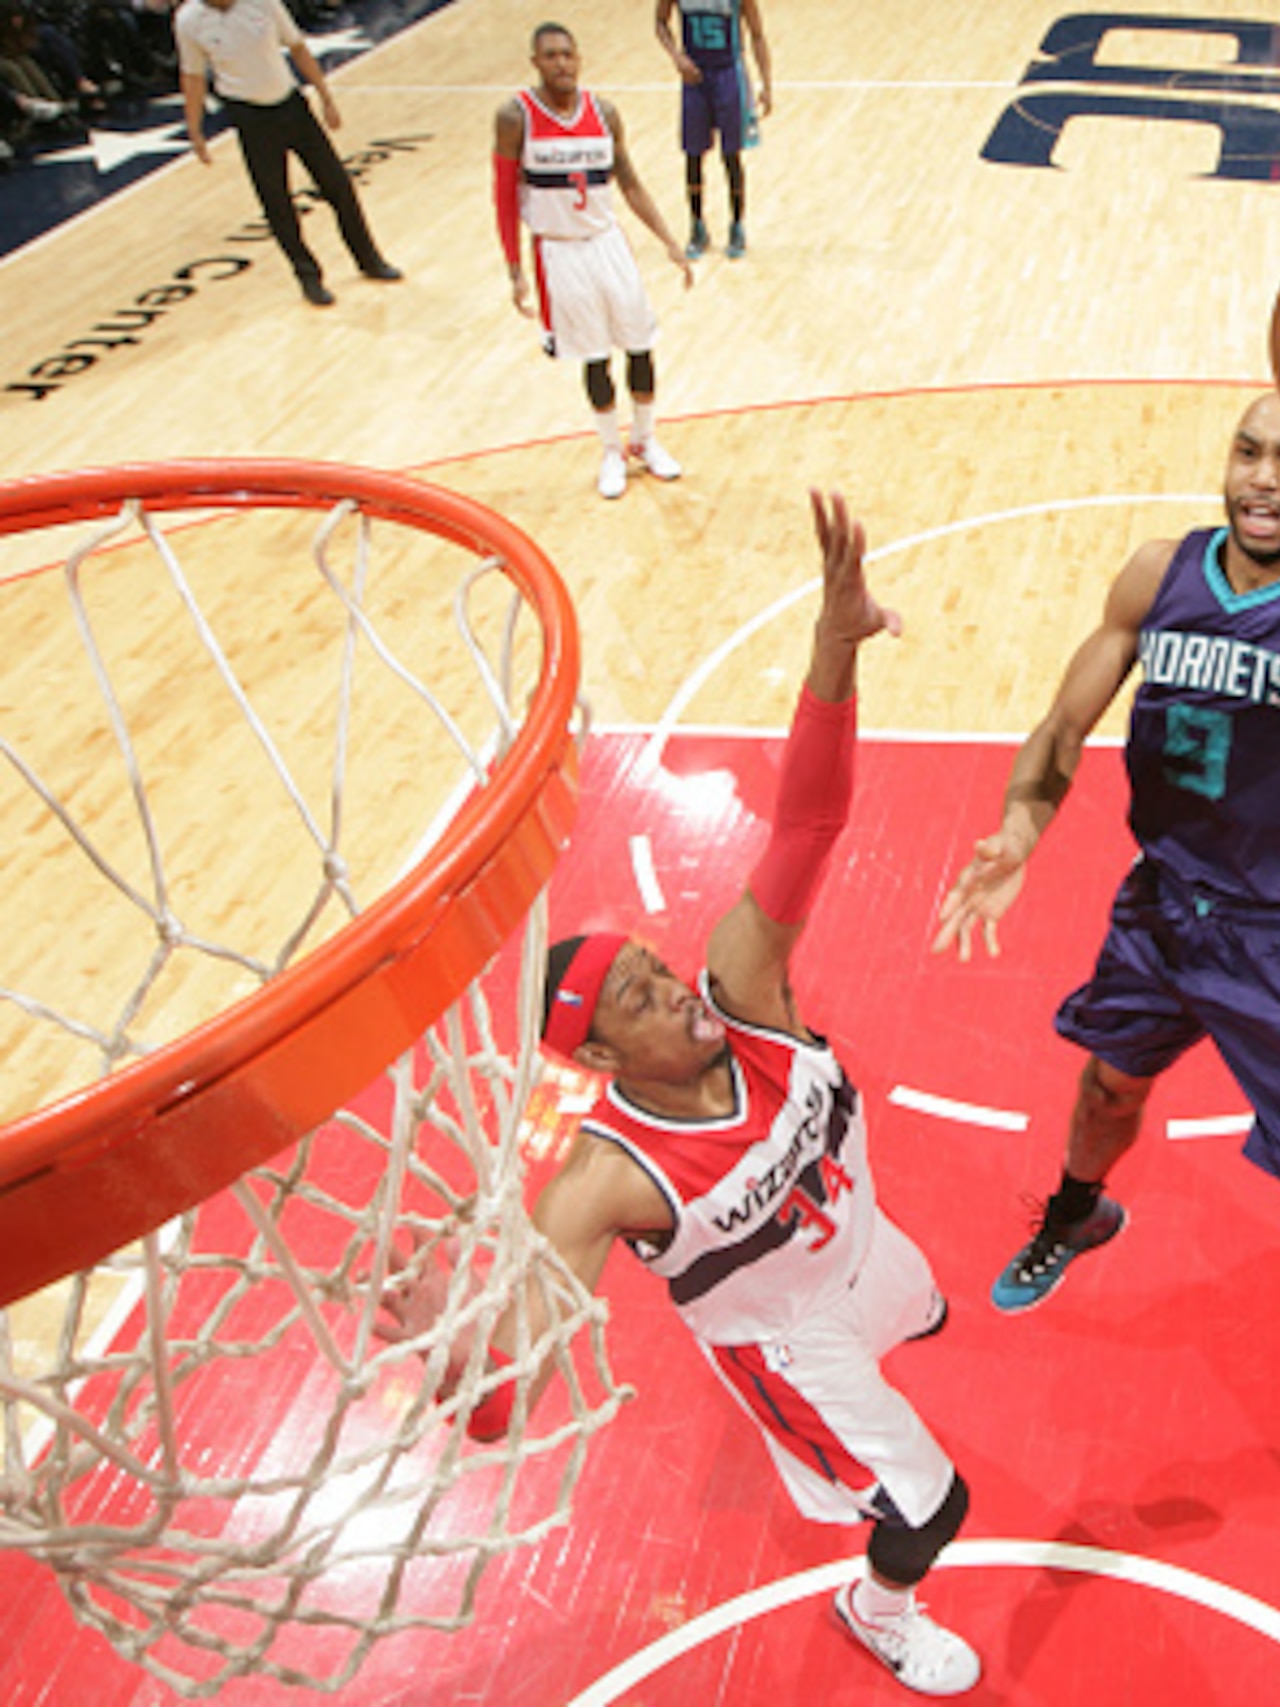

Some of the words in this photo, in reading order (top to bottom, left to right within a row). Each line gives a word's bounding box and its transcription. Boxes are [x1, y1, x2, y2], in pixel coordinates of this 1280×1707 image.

[688, 15, 727, 49] 15
[567, 171, 588, 211] 3
[4, 256, 252, 400] Center
[1163, 701, 1233, 800] 9
[777, 1153, 855, 1252] 34
